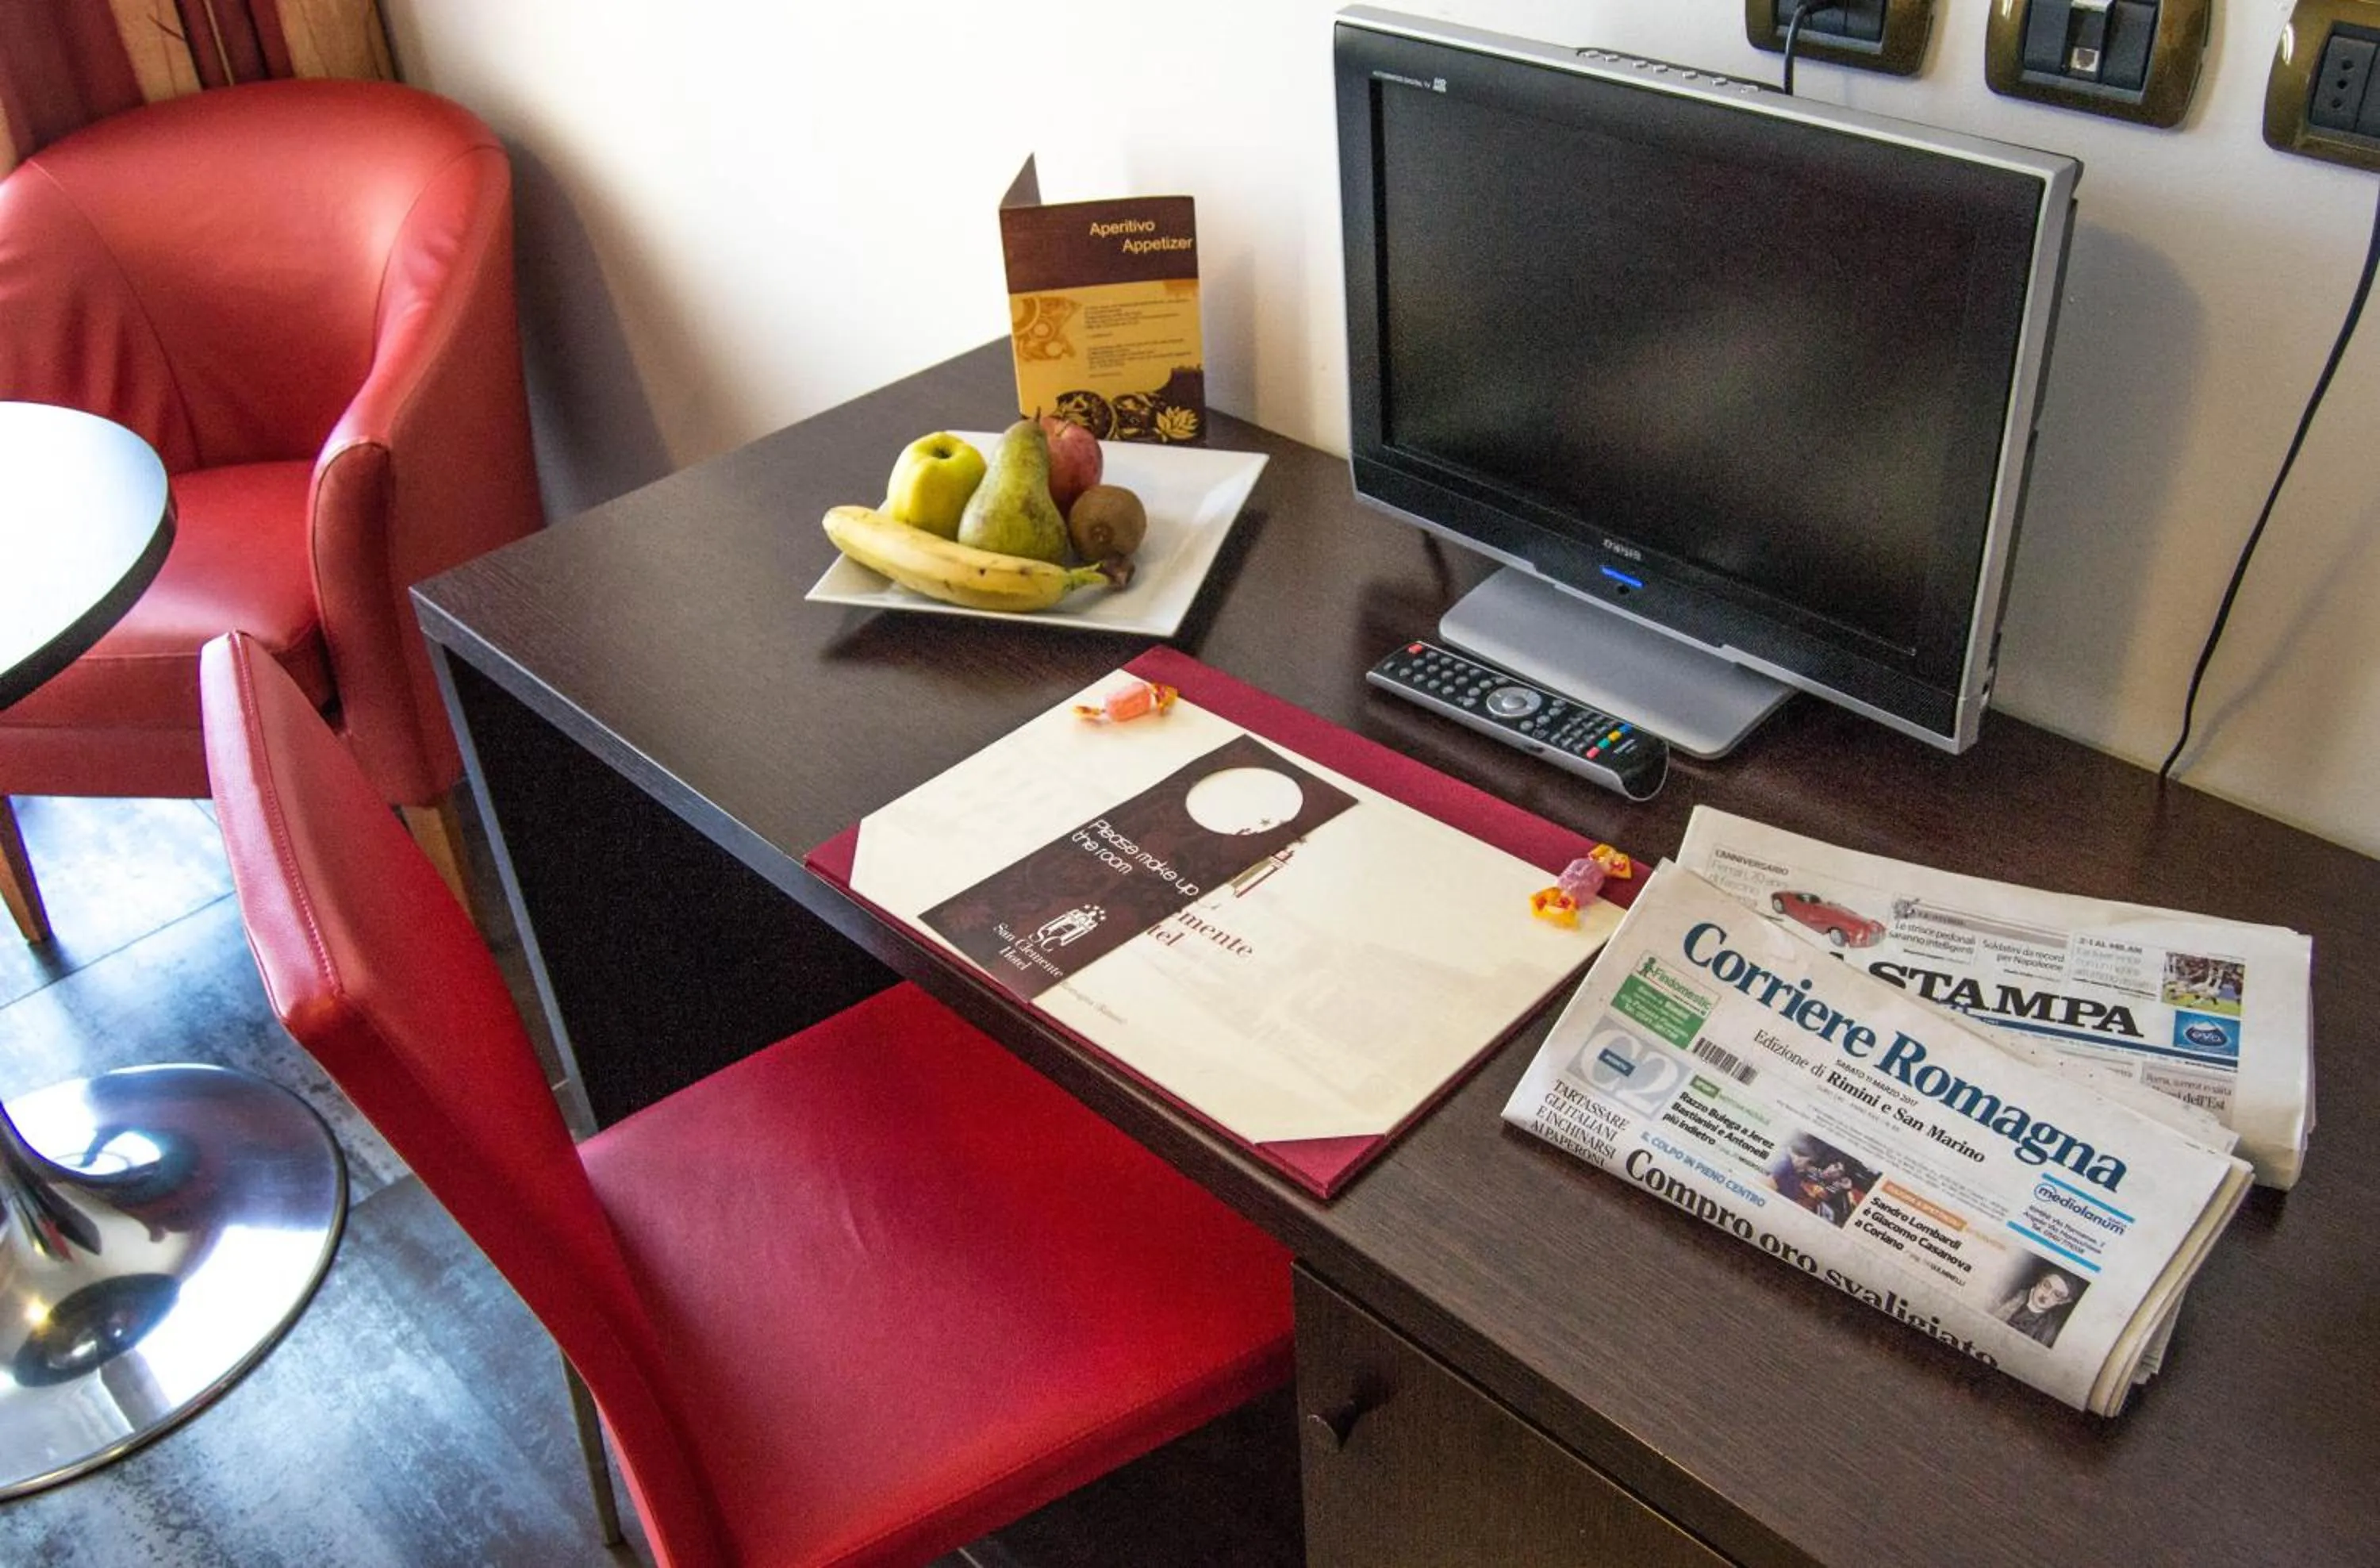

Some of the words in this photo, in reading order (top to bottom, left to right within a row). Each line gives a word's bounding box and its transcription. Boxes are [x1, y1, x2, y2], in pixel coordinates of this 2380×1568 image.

[1089, 220, 1156, 238] Aperitivo
[1122, 238, 1193, 254] Appetizer
[1072, 830, 1099, 851] the
[1095, 848, 1133, 874] room
[1088, 819, 1139, 855] Please
[1135, 851, 1177, 881] make
[1175, 878, 1200, 896] up
[993, 922, 1016, 942] San
[1015, 939, 1064, 978] Clemente
[999, 946, 1032, 970] Hotel
[1147, 924, 1184, 947] tel
[1178, 912, 1253, 955] mente
[1868, 961, 2144, 1038] STAMPA
[1683, 922, 1876, 1058] Corriere
[1873, 1030, 2127, 1193] Romagna
[1545, 1093, 1566, 1113] GLI
[1564, 1104, 1618, 1142] ITALIANI
[1554, 1079, 1630, 1132] TARTASSARE
[1679, 1091, 1709, 1113] Razzo
[1708, 1108, 1741, 1132] Bulega
[1746, 1130, 1775, 1149] Jerez
[1753, 1029, 1809, 1069] Edizione
[1810, 1064, 1826, 1078] di
[1826, 1071, 1880, 1107] Rimini
[1880, 1102, 1892, 1115] e
[1892, 1107, 1925, 1132] San
[1925, 1124, 1986, 1163] Marino
[1530, 1120, 1545, 1136] AI
[1545, 1128, 1606, 1167] PAPERONI
[1536, 1105, 1548, 1118] E
[1546, 1111, 1617, 1159] INCHINARSI
[1672, 1102, 1718, 1132] Bastianini
[1725, 1132, 1770, 1160] Antonelli
[1678, 1119, 1716, 1146] indietro
[1651, 1136, 1683, 1160] COLPO
[1683, 1155, 1695, 1169] IN
[1695, 1161, 1726, 1185] PIENO
[1726, 1178, 1767, 1207] CENTRO
[1626, 1149, 1753, 1239] Compro
[1760, 1232, 1818, 1274] oro
[1863, 1223, 1905, 1251] Coriano
[1871, 1196, 1908, 1221] Sandro
[1909, 1216, 1963, 1251] Lombardi
[2039, 1186, 2125, 1236] mediolanum
[1871, 1213, 1917, 1242] Giacomo
[1918, 1237, 1973, 1274] Casanova
